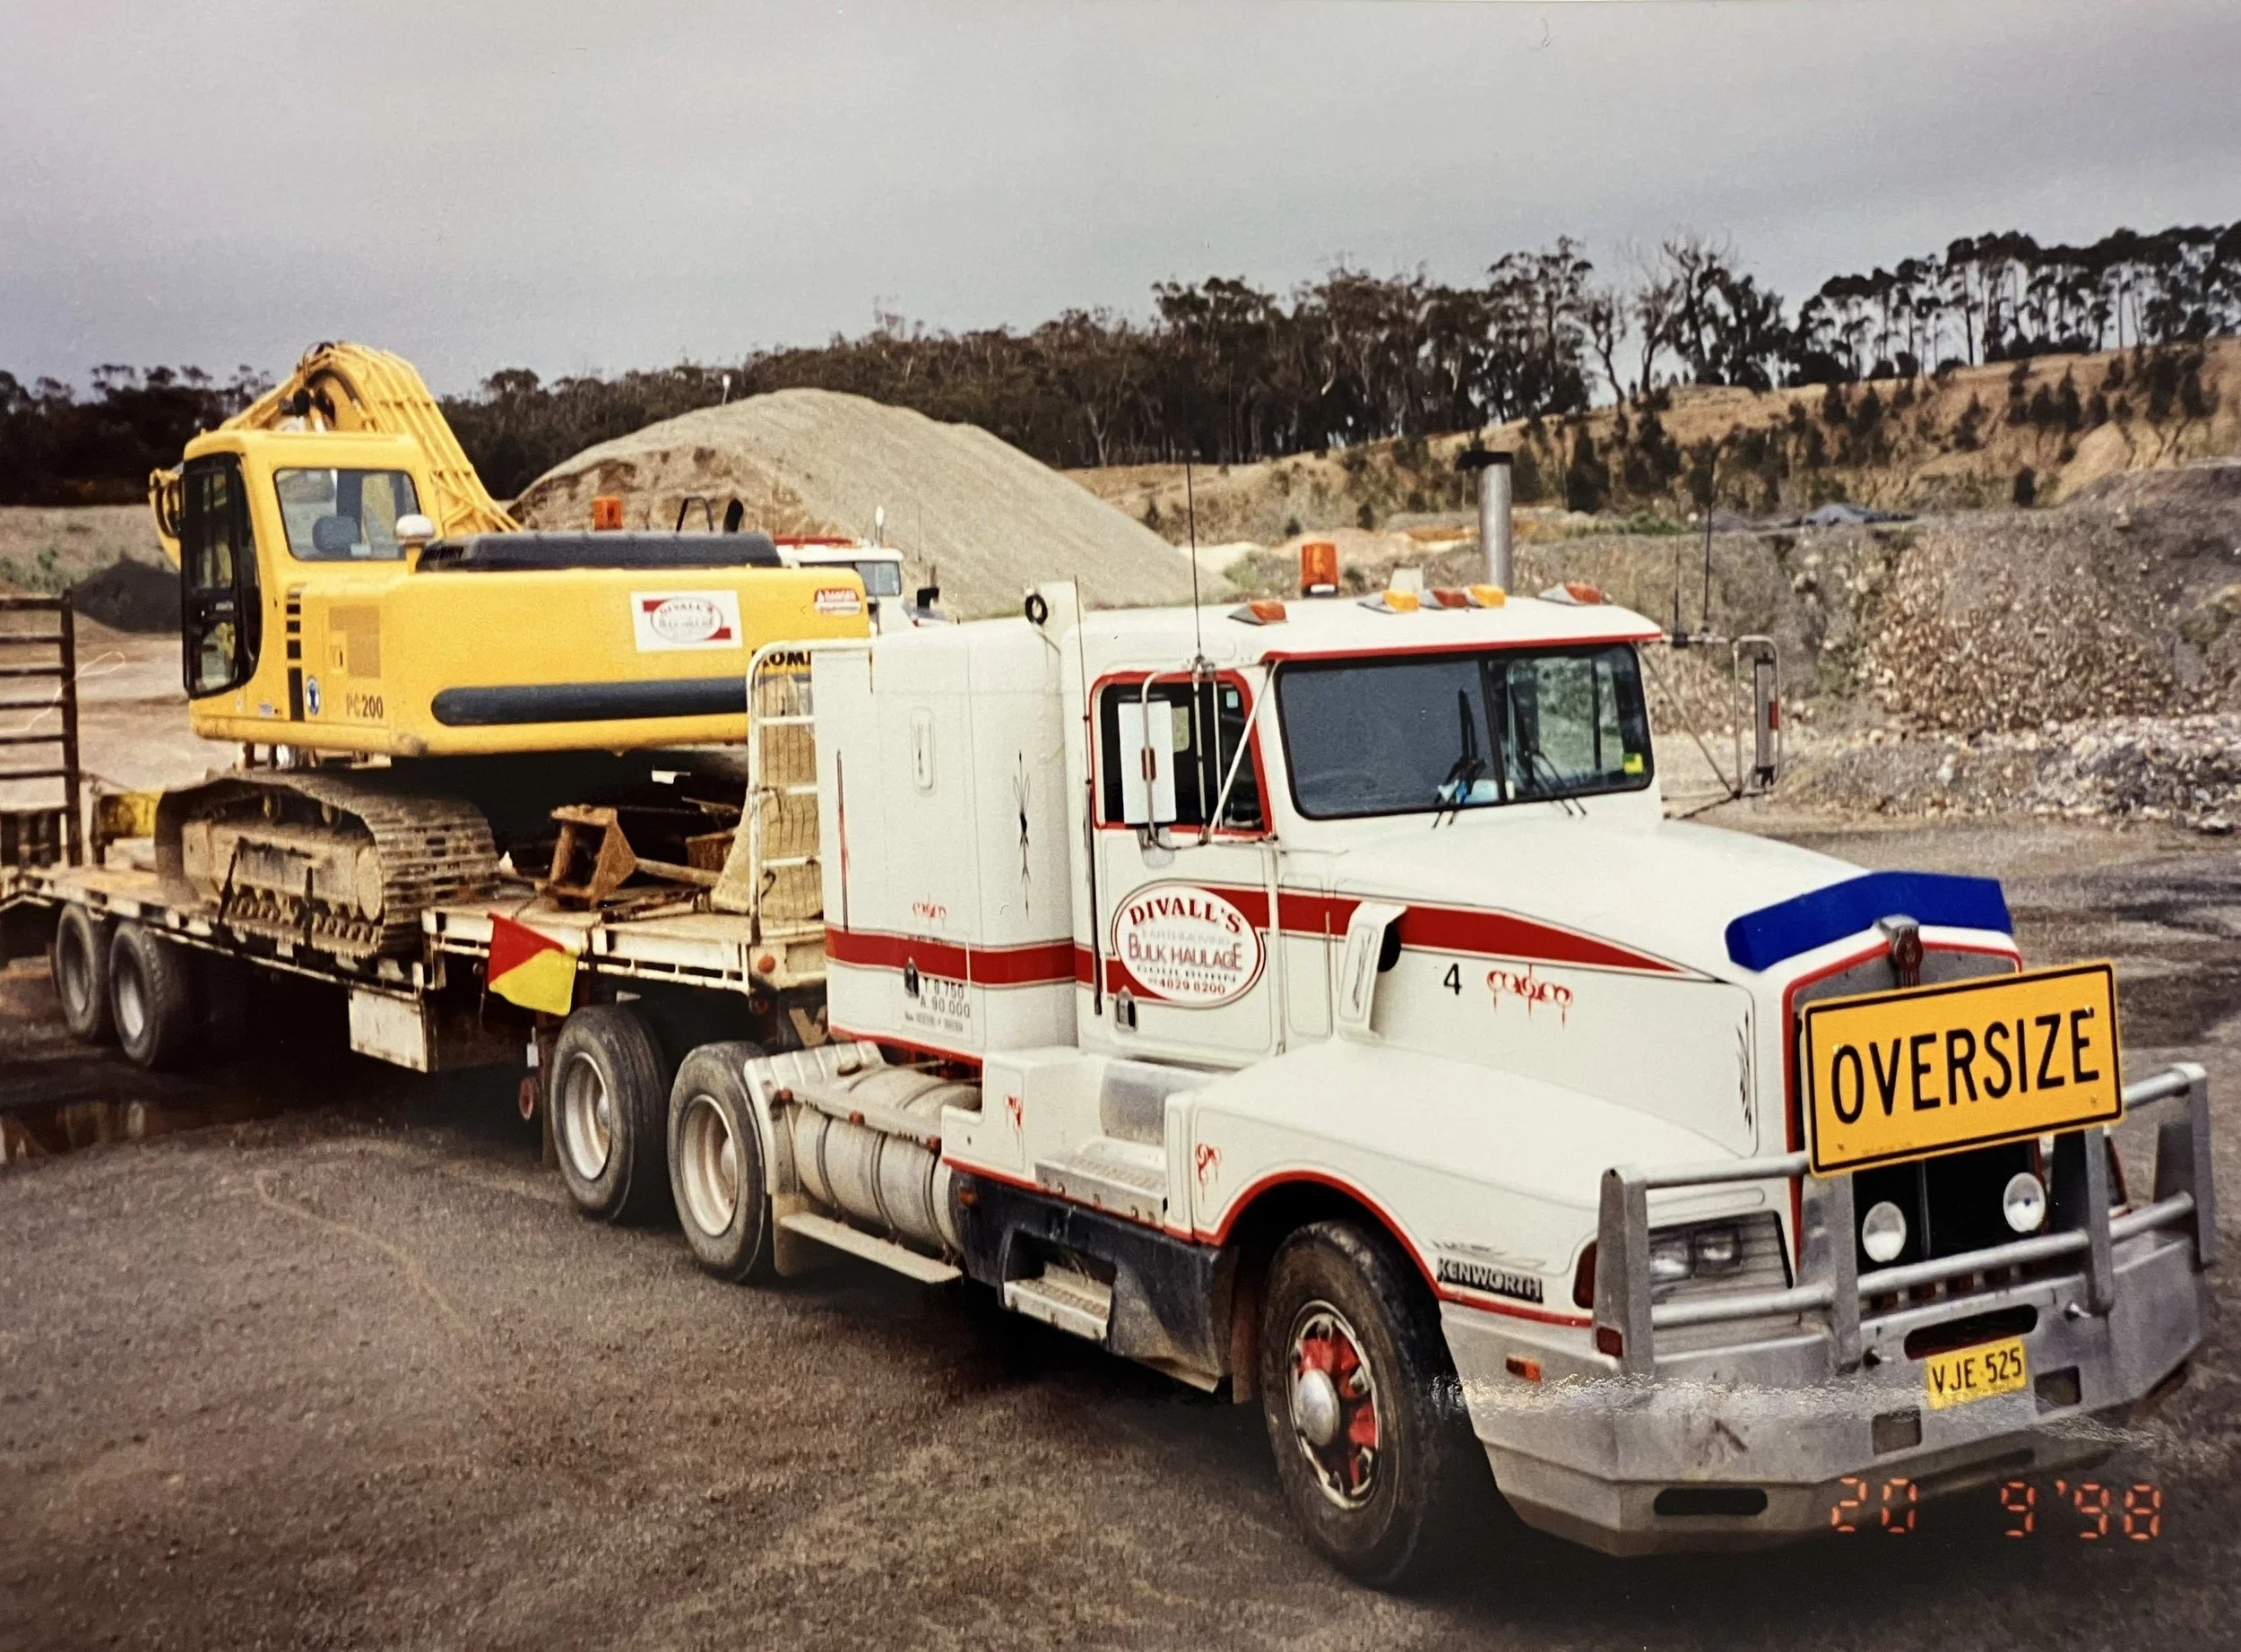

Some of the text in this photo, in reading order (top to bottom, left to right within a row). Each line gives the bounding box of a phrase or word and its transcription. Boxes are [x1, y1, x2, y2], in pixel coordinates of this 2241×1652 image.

[347, 692, 384, 719] PC200
[1129, 896, 1242, 934] DIVALL'S
[1129, 932, 1242, 971] BULK HAULAGE
[1443, 963, 1462, 996] 4
[1831, 1007, 2099, 1124] OVERSIZE
[1437, 1257, 1541, 1299] KENWORTH
[1932, 1347, 2023, 1394] VJE 525
